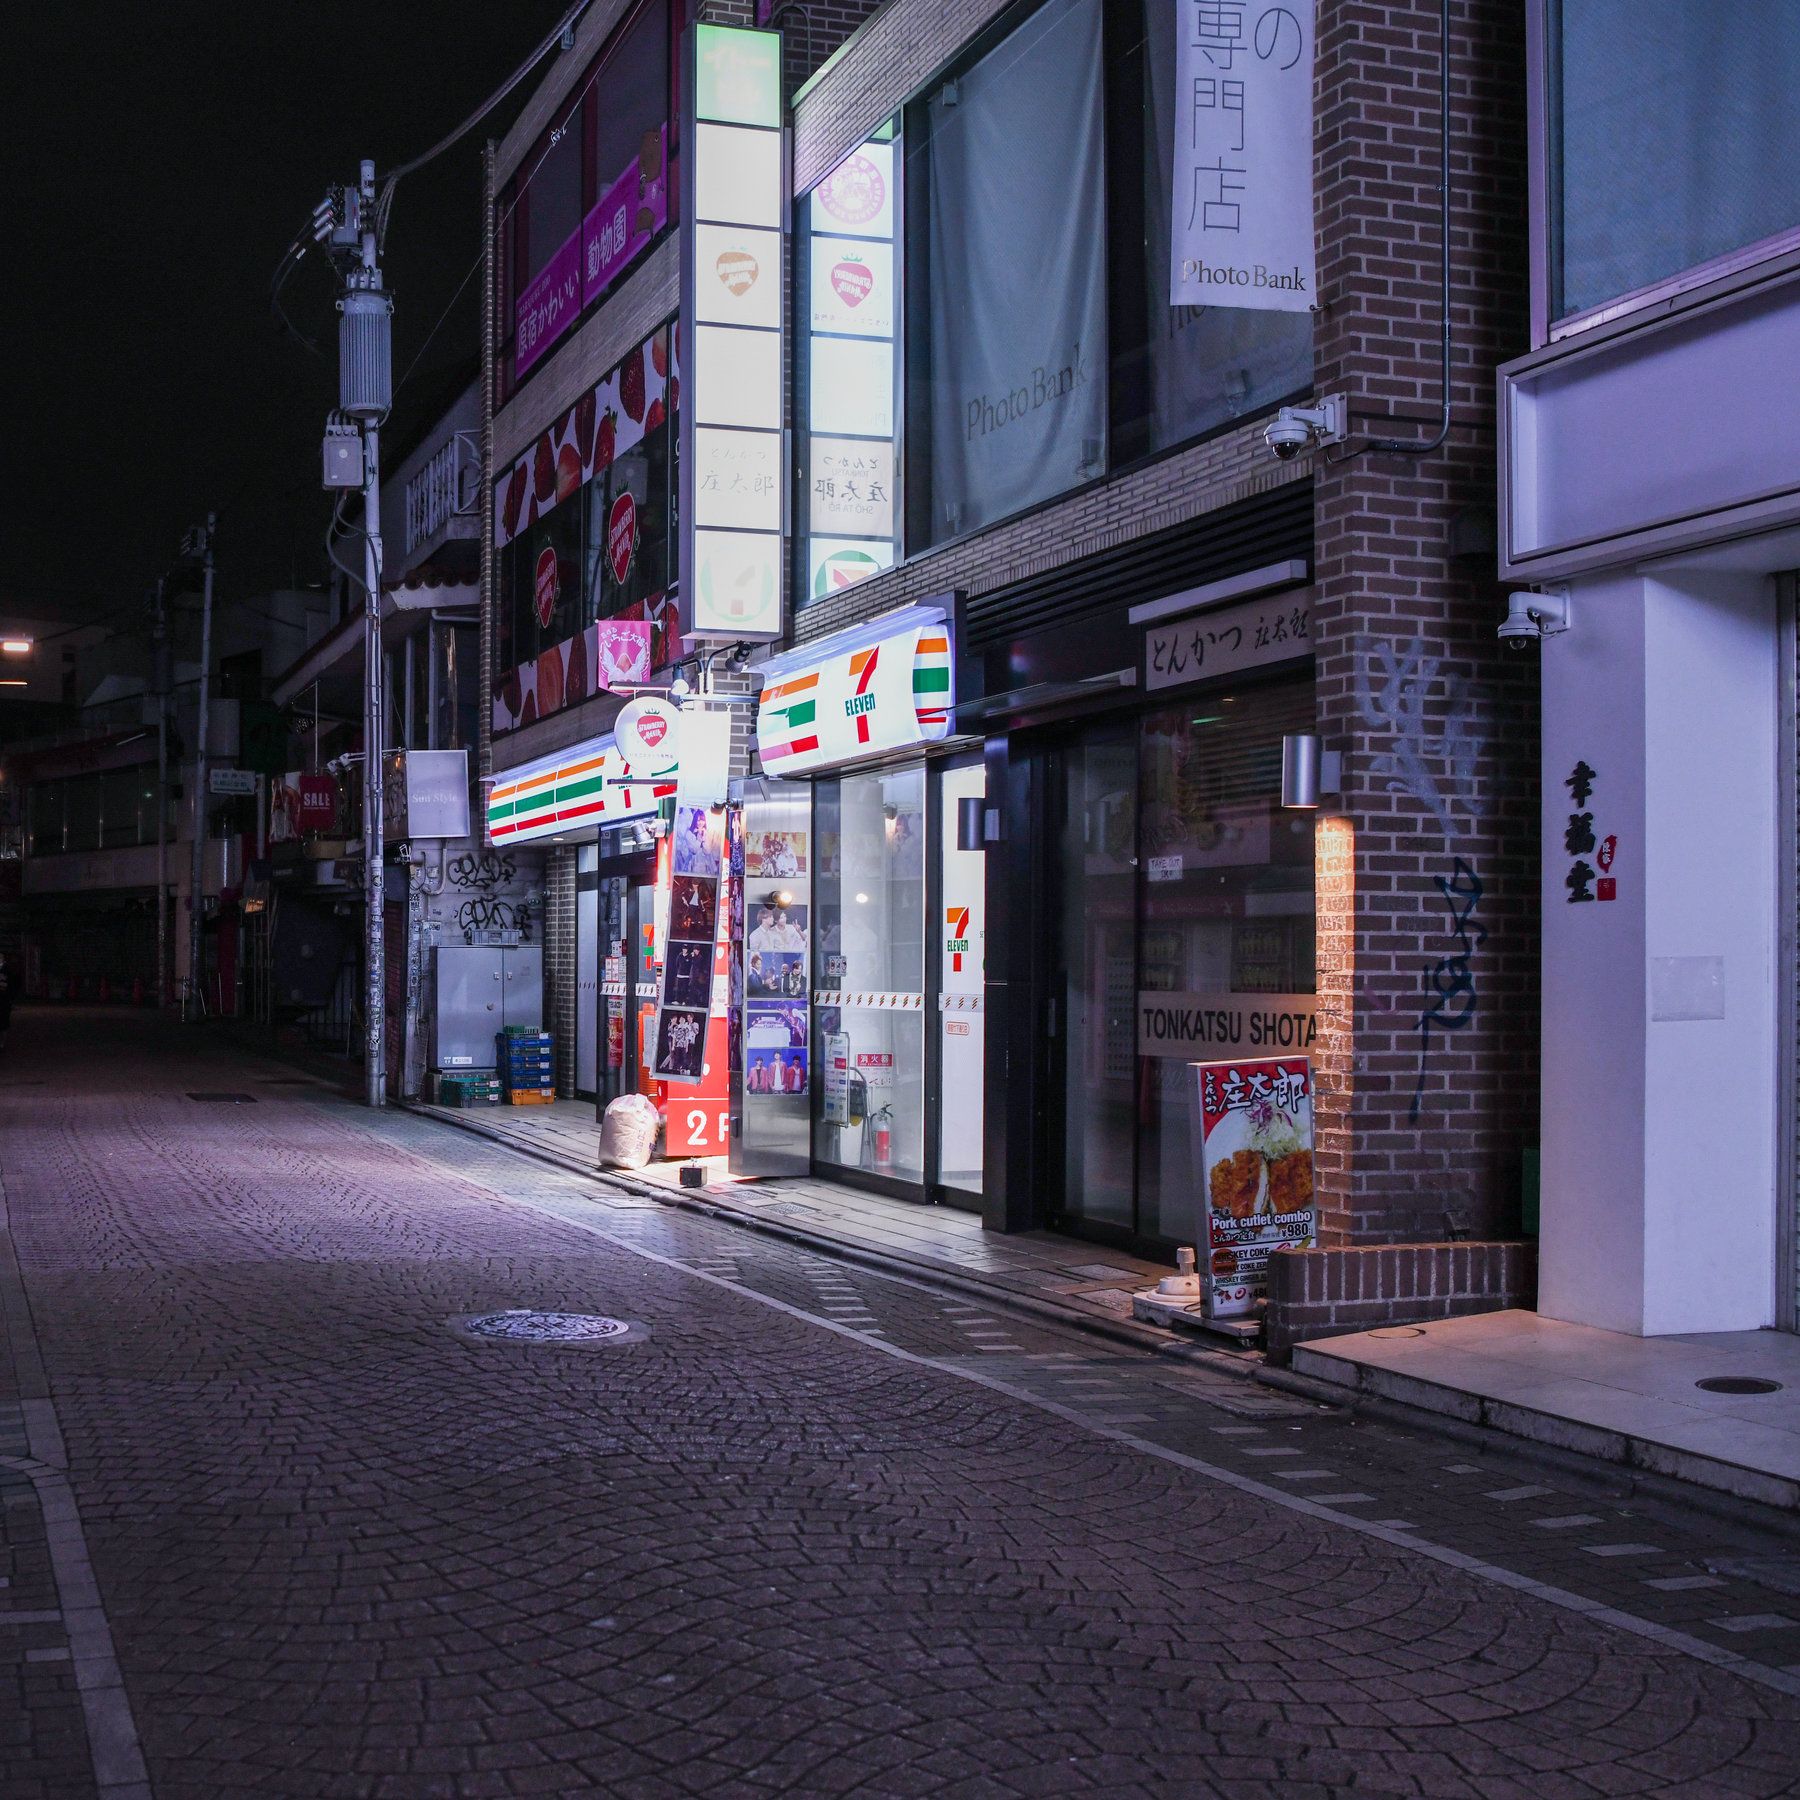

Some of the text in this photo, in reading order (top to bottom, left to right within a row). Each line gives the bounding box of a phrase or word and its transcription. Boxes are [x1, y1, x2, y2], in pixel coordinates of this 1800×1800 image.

[1254, 8, 1302, 71] の
[587, 204, 627, 282] 動物園
[700, 470, 775, 497] 庄太郎
[1153, 627, 1242, 675] とんかつ
[849, 645, 879, 744] 7
[303, 792, 331, 806] SALE
[947, 907, 969, 972] 7
[1143, 1008, 1317, 1048] TONKATSU SHOTA
[860, 1054, 889, 1064] 消火器
[1205, 1071, 1218, 1113] とんかつ
[1218, 1065, 1305, 1113] 庄太郎
[1212, 1210, 1312, 1231] Pork cutlet combo
[1282, 1223, 1309, 1238] ¥980
[1250, 1248, 1269, 1257] COKE
